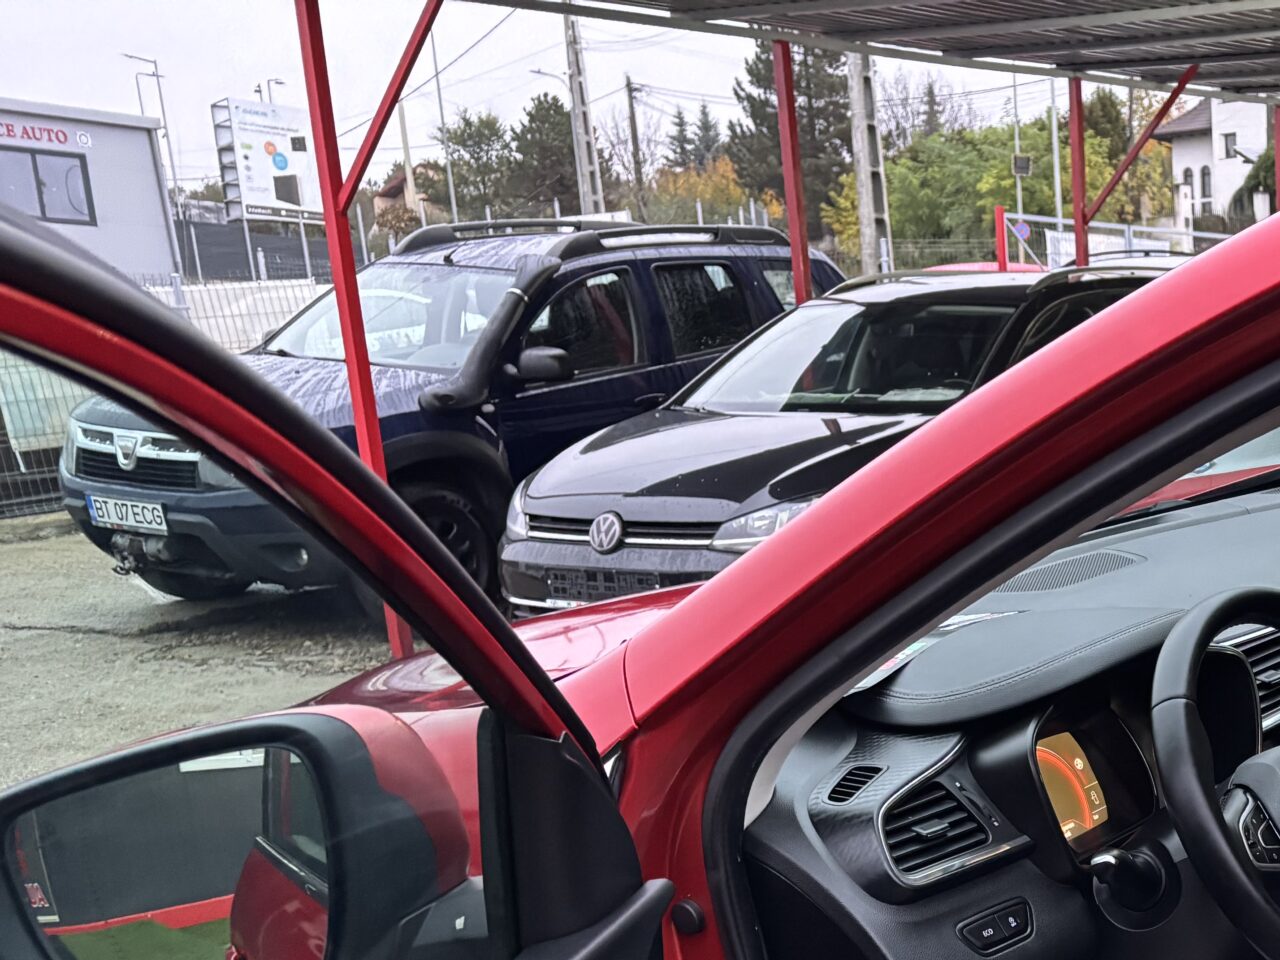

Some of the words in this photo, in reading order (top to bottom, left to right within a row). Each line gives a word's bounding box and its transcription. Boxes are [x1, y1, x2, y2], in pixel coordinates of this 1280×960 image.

[21, 125, 68, 144] AUTO
[93, 499, 110, 519] BT
[114, 502, 129, 522] 07
[132, 504, 163, 526] ECG
